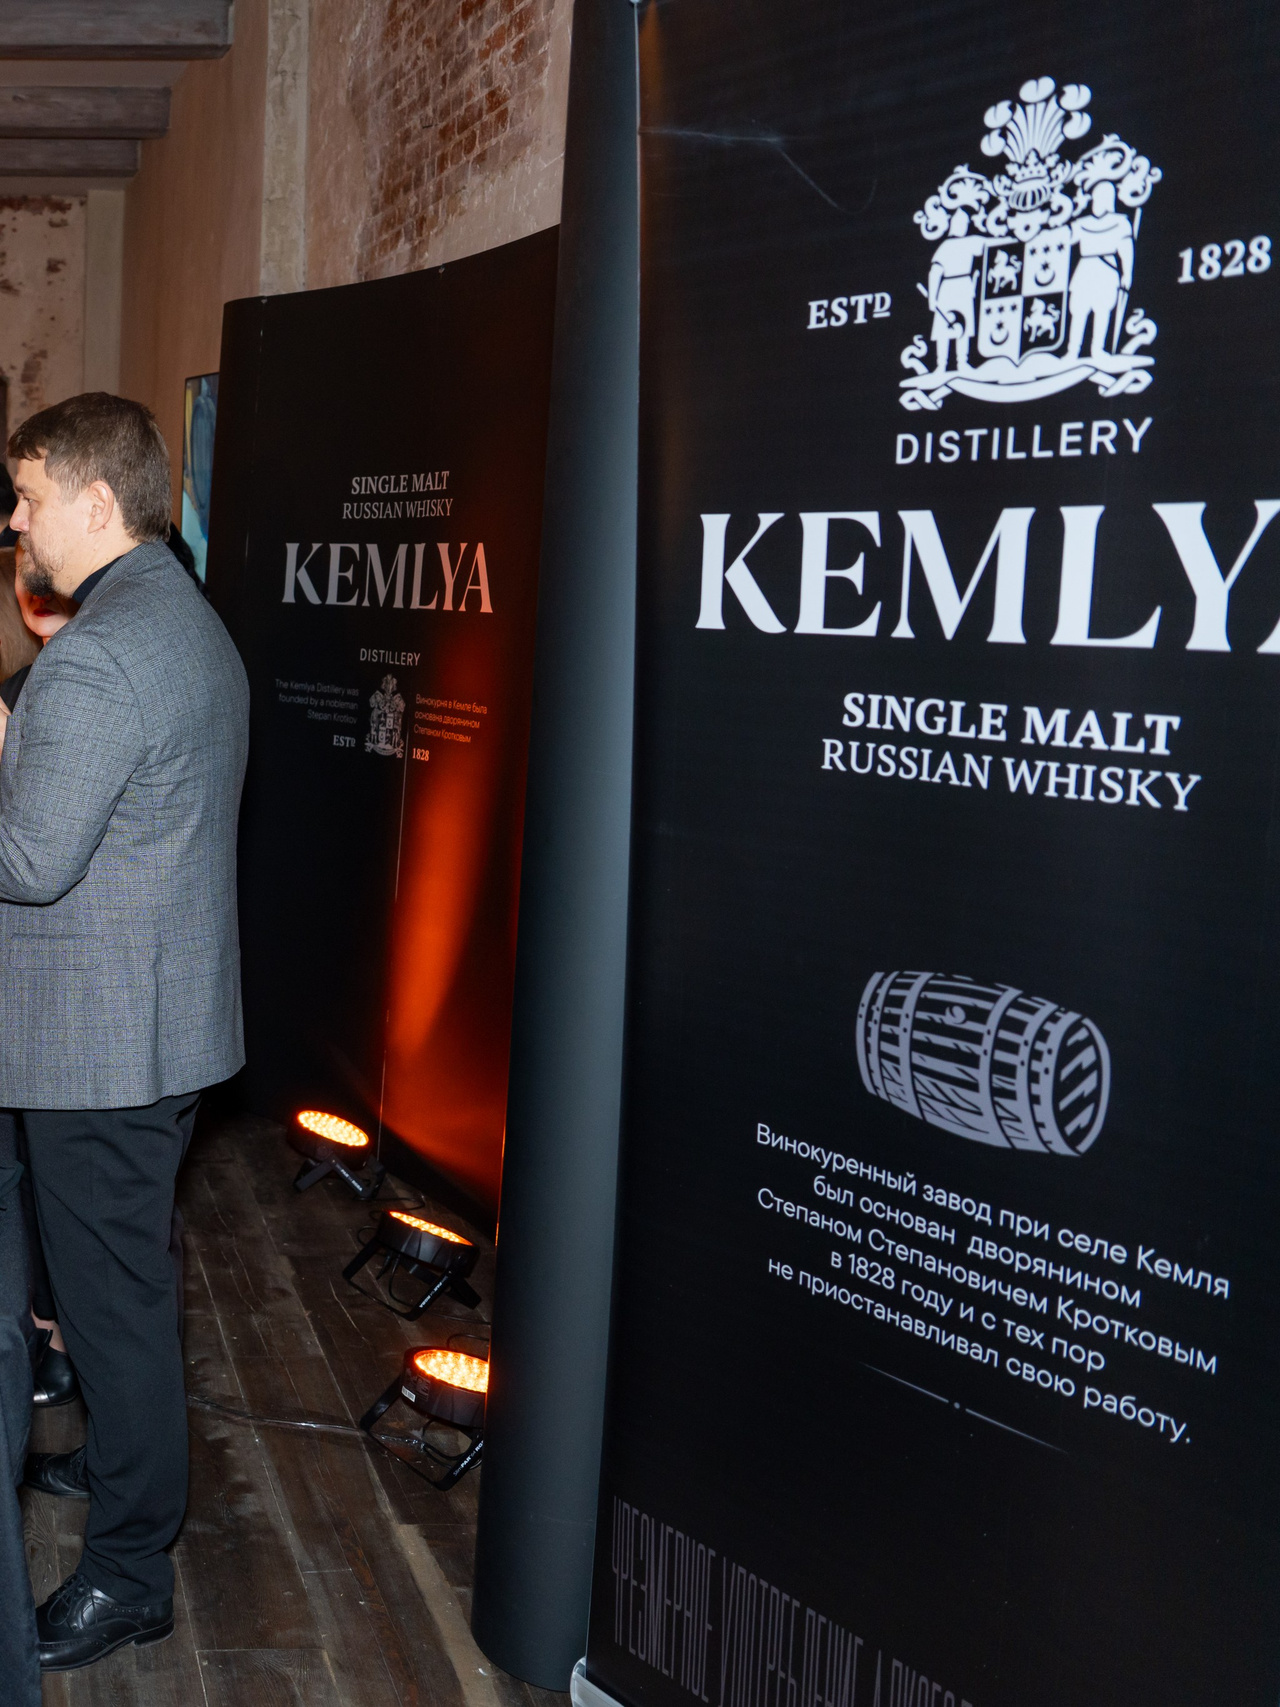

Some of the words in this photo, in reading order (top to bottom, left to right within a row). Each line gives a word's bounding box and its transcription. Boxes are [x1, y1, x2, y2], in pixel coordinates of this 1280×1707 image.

[1177, 234, 1273, 284] 1828
[895, 416, 1154, 465] DISTILLERY
[342, 501, 403, 519] RUSSIAN
[405, 498, 454, 518] WHISKY
[351, 475, 409, 495] SINGLE
[411, 470, 450, 493] MALT
[281, 541, 494, 614] KEMLYA
[694, 499, 1280, 655] KEMLY
[359, 648, 421, 667] DISTILLERY
[412, 747, 430, 762] 1828
[841, 692, 1009, 742] SINGLE
[1020, 705, 1182, 756] MALT
[820, 738, 994, 790] RUSSIAN
[1001, 756, 1202, 812] WHISKY
[756, 1122, 917, 1197] Винокуренный
[922, 1184, 993, 1227] завод
[998, 1208, 1050, 1242] при
[1057, 1228, 1129, 1265] селе
[1136, 1244, 1230, 1300] Кемля
[813, 1174, 854, 1208] был
[859, 1196, 956, 1246] основан
[966, 1235, 1142, 1309] дворянином
[757, 1187, 863, 1244] Степаном
[867, 1228, 1049, 1315] Степановичем
[1056, 1295, 1218, 1375] Кротковым
[830, 1251, 842, 1269] в
[848, 1252, 896, 1290] 1828
[901, 1279, 954, 1317] году
[959, 1302, 975, 1323] и
[981, 1311, 997, 1331] с
[1002, 1318, 1045, 1350] тех
[1051, 1336, 1106, 1373] пор
[768, 1258, 794, 1281] не
[798, 1270, 999, 1368] приостанавливал
[1005, 1357, 1076, 1397] свою
[1083, 1385, 1191, 1443] работу.
[612, 1496, 716, 1703] ЧРЕЗМЕРНОЕ
